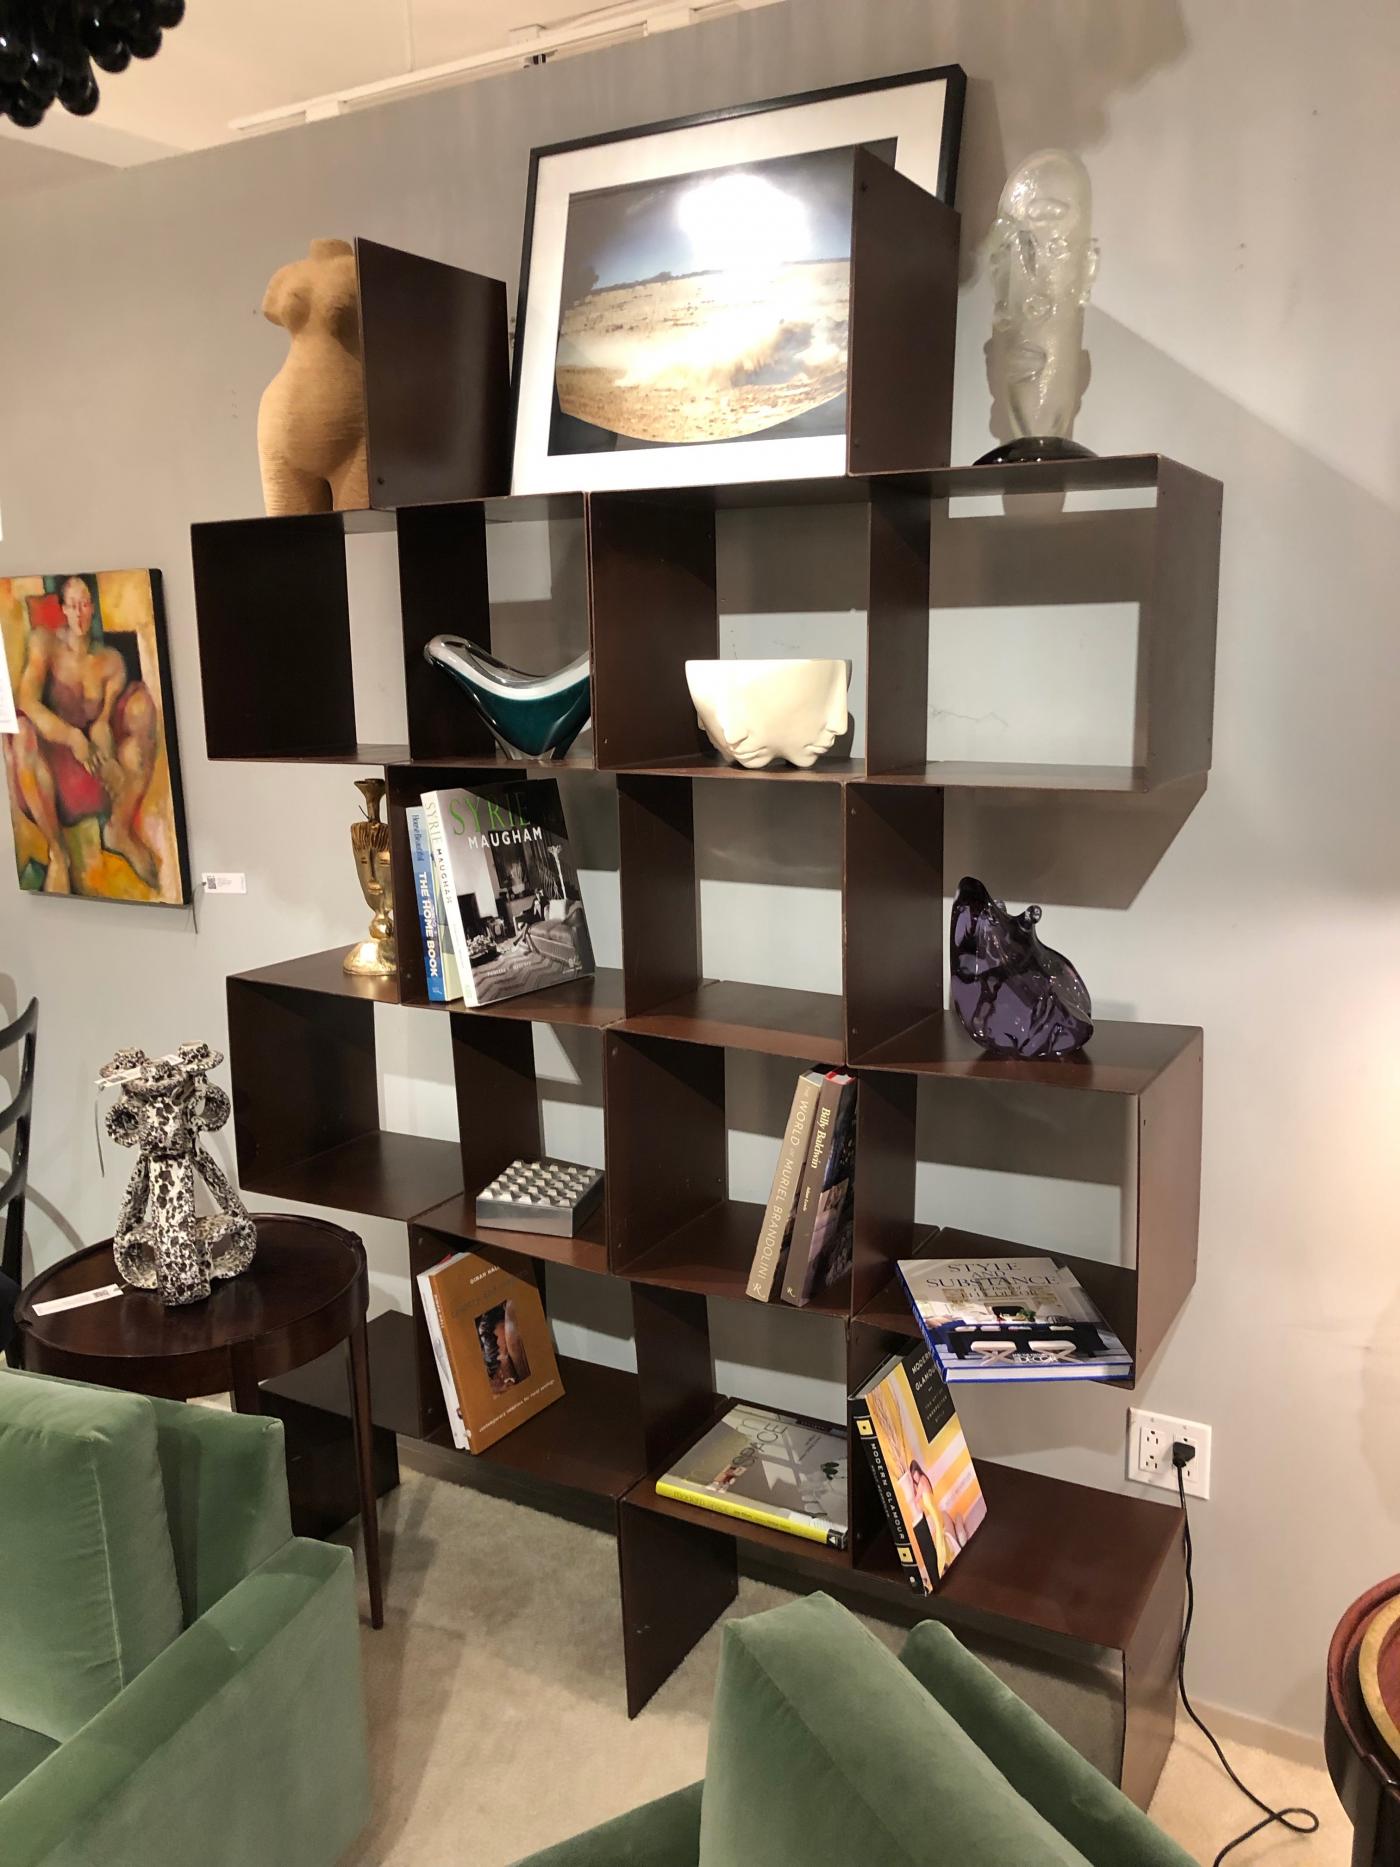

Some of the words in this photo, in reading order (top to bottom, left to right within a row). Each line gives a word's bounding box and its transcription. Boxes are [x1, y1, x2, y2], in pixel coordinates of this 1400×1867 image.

[448, 793, 531, 836] SYRIE
[467, 826, 543, 850] MAUGHAM
[418, 871, 430, 897] THE
[436, 848, 452, 904] MAUGHAM
[421, 898, 434, 938] HOME
[427, 940, 438, 977] BOOK
[790, 1100, 809, 1146] WORLD
[816, 1106, 831, 1130] Billy
[810, 1129, 827, 1169] Baldwin
[774, 1158, 794, 1201] MURIEL
[757, 1205, 783, 1279] BRANDOLINI
[926, 1276, 1061, 1288] SUBSTANCE
[947, 1262, 1020, 1273] STYLE
[971, 1270, 1005, 1280] AND
[871, 1443, 888, 1486] MODERN
[885, 1491, 905, 1539] GLAMOUR
